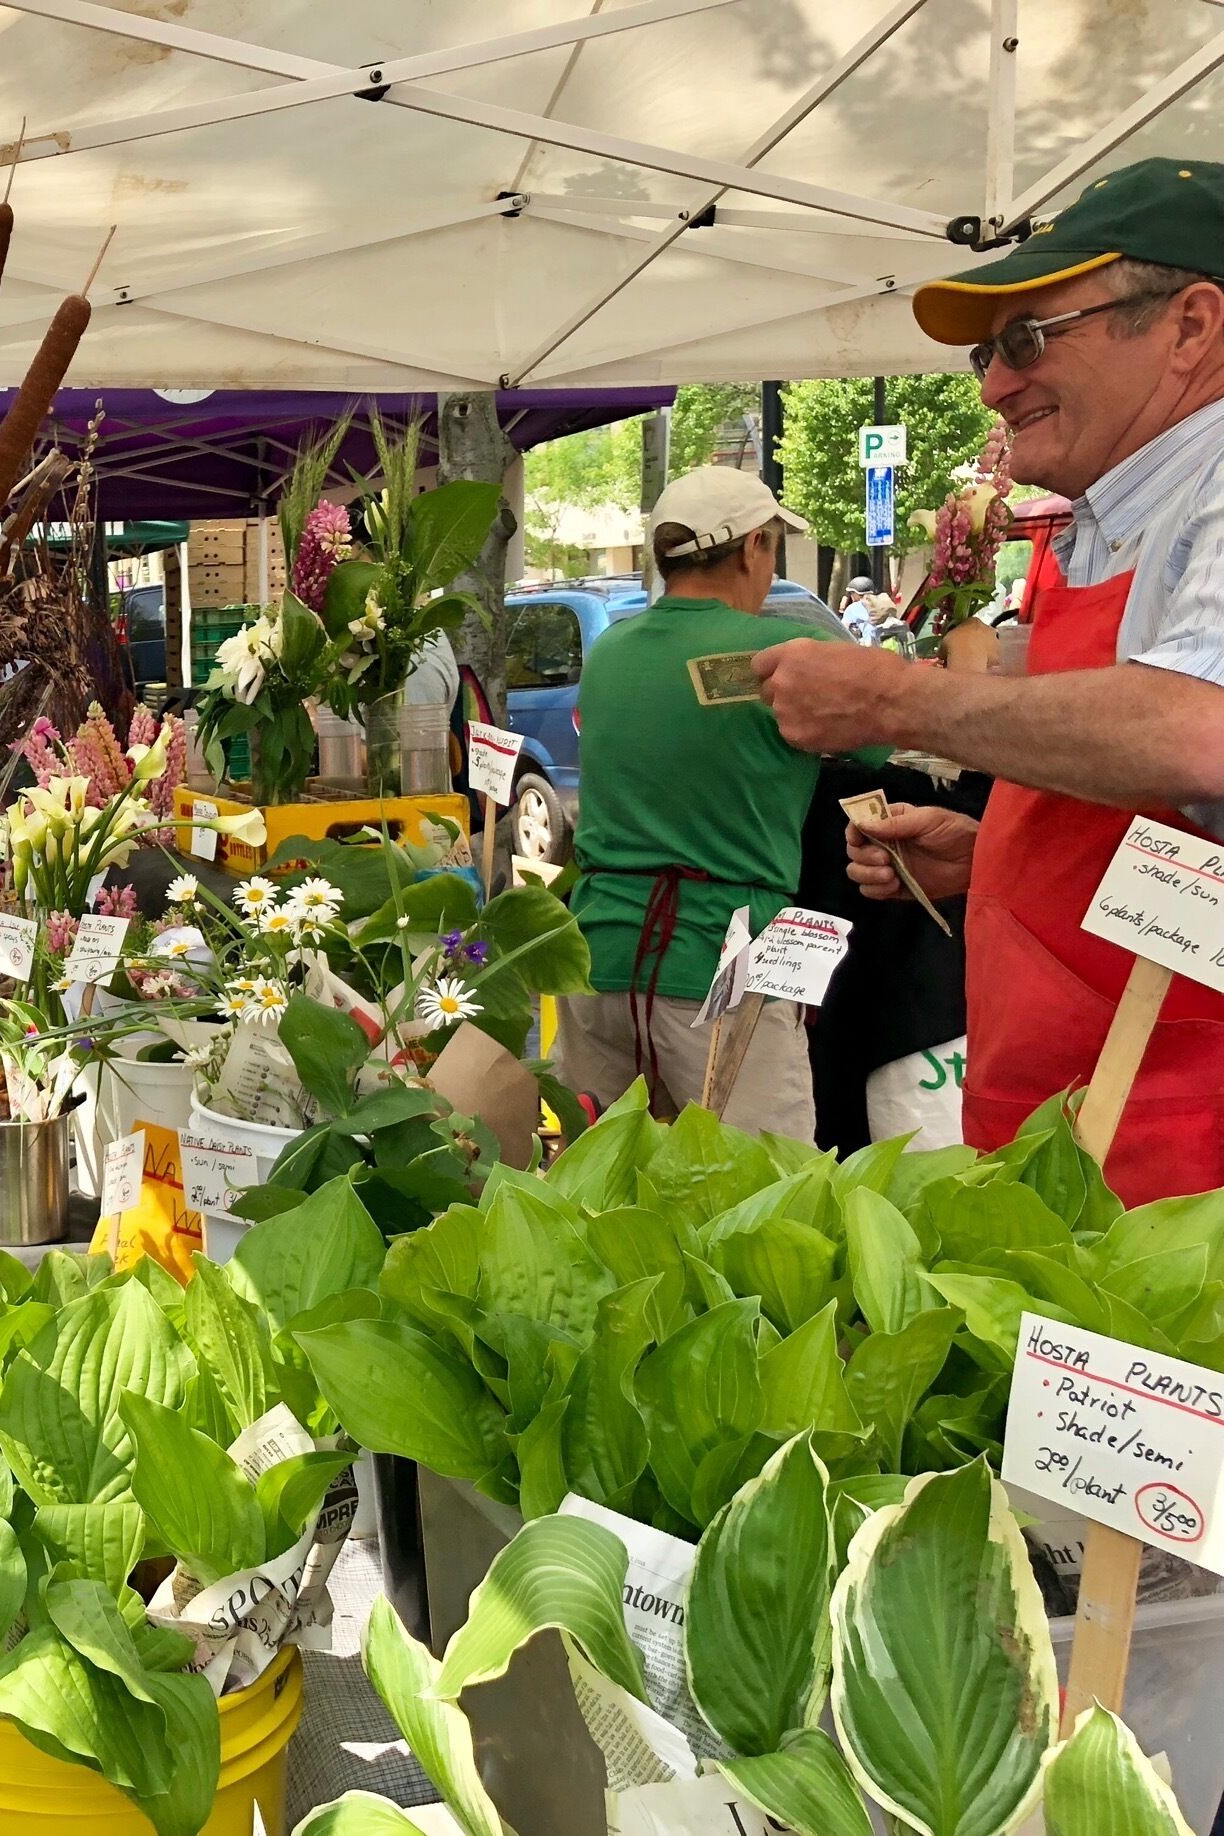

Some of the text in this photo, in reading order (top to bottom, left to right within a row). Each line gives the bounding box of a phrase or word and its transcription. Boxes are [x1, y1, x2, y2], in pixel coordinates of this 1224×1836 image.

[1127, 825, 1181, 859] HOSTA
[792, 911, 836, 930] PLANTS
[801, 929, 840, 945] blossom
[766, 944, 788, 955] plant
[806, 942, 843, 955] parent
[1026, 1325, 1223, 1417] HOSTA PLANTS
[1056, 1377, 1136, 1421] Patriot
[1056, 1411, 1192, 1472] Shade/semi
[208, 1566, 303, 1632] SPOT
